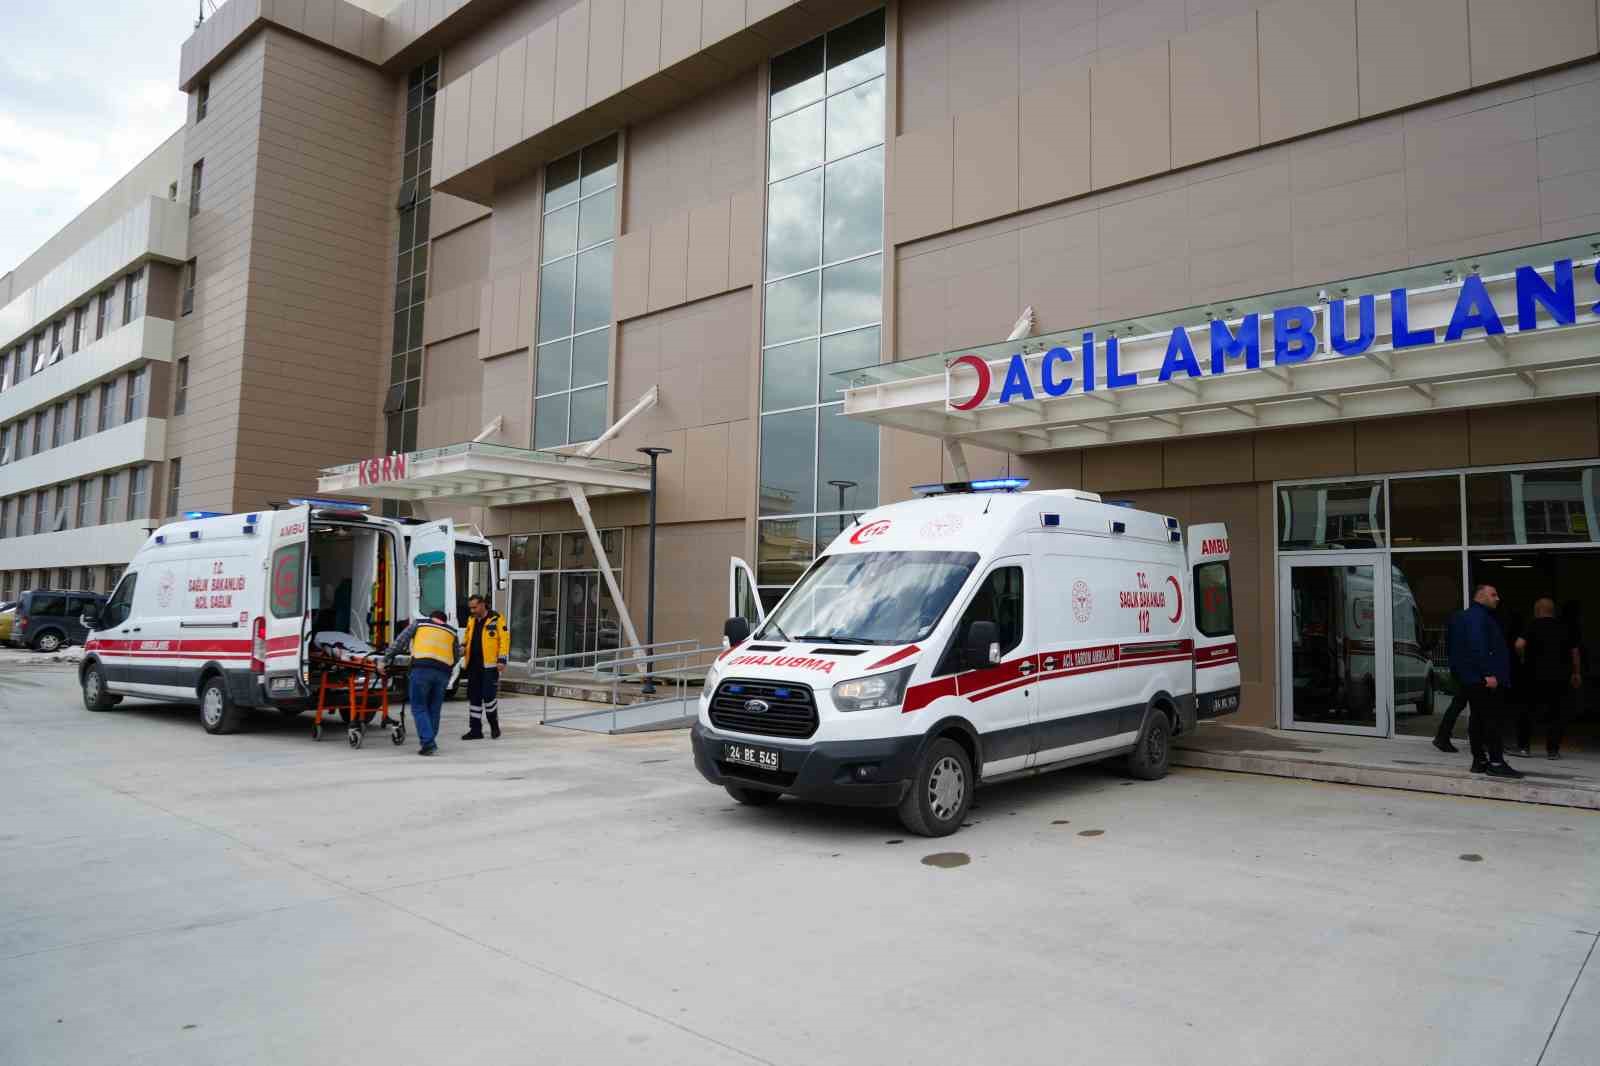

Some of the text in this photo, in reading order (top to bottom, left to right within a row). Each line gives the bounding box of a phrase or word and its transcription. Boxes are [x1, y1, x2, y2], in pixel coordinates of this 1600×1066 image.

[999, 257, 1600, 404] ACİL AMBULAN
[359, 455, 406, 485] KBRN
[1202, 538, 1230, 555] AMBU
[1138, 610, 1150, 633] 112
[730, 746, 741, 759] 24
[759, 751, 778, 766] 545
